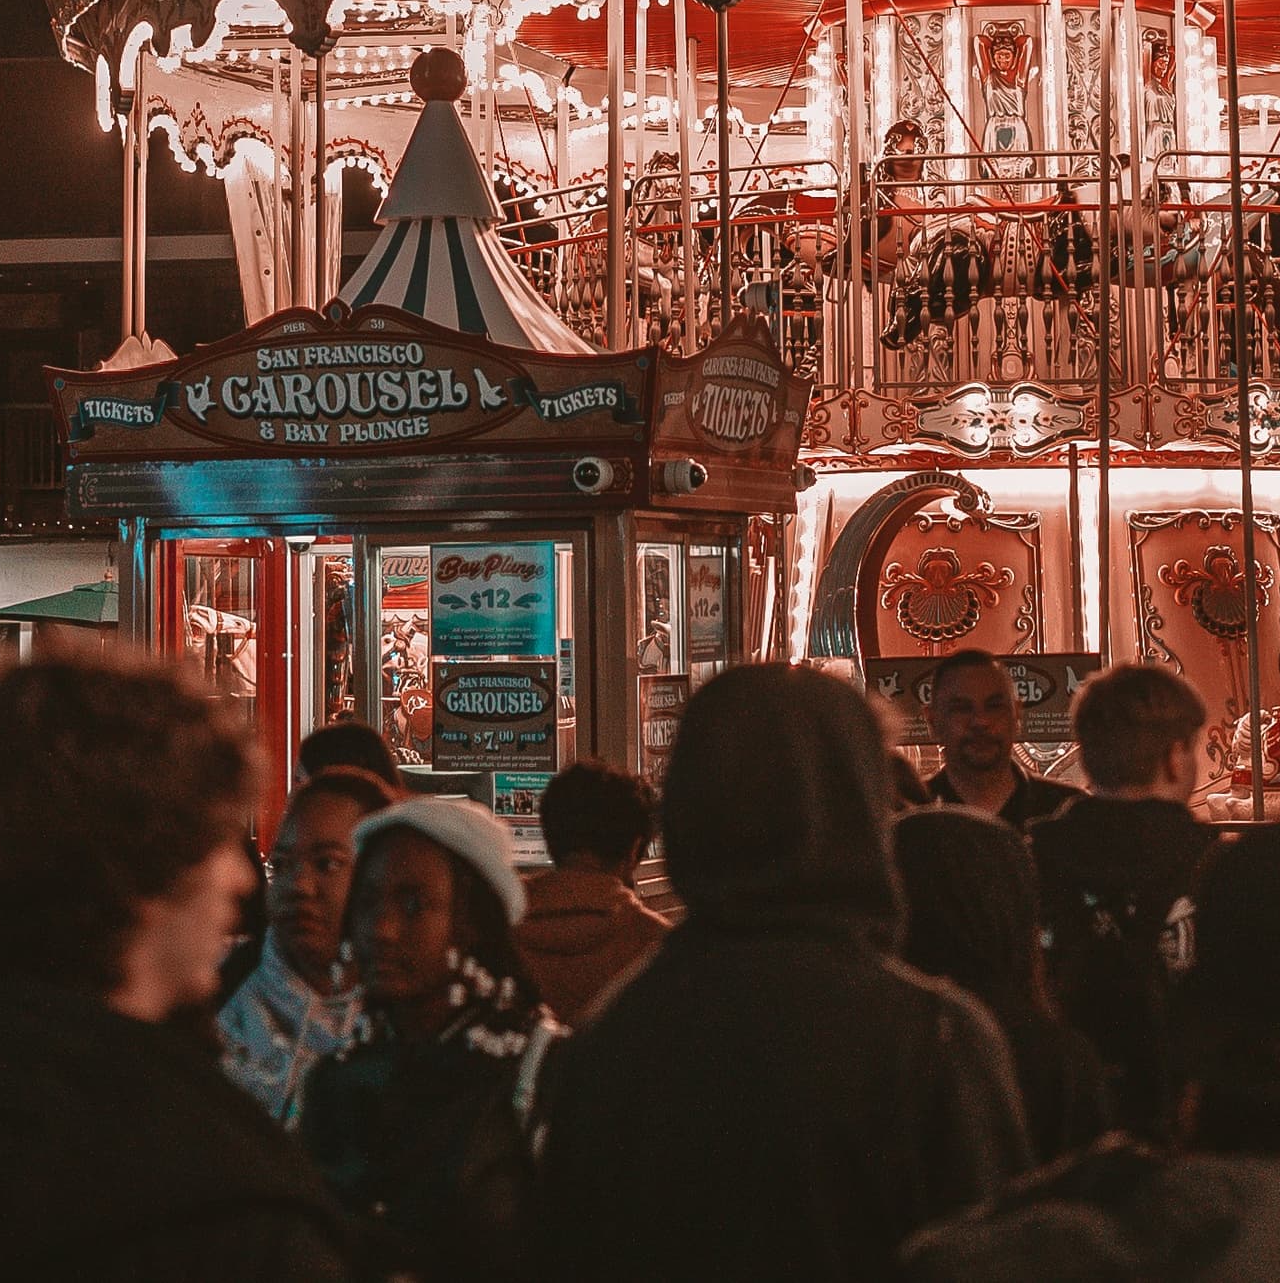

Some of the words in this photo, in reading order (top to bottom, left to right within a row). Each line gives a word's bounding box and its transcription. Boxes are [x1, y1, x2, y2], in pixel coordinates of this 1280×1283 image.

[283, 322, 306, 334] PIER
[370, 318, 385, 329] 39
[256, 347, 300, 370] SAN
[303, 342, 424, 366] FRANCISCO
[222, 368, 469, 417] CAROUSEL
[540, 386, 618, 419] TICKETS
[83, 399, 155, 424] TICKETS
[702, 383, 771, 440] TICKETS
[260, 421, 276, 442] &
[284, 422, 329, 443] BAY
[339, 416, 430, 443] PLUNGE
[435, 557, 482, 585] Bay
[481, 552, 546, 584] Plunge
[470, 587, 511, 610] $12
[458, 677, 478, 689] SAN
[479, 676, 531, 689] FRANCISCO
[446, 692, 544, 715] CAROUSEL
